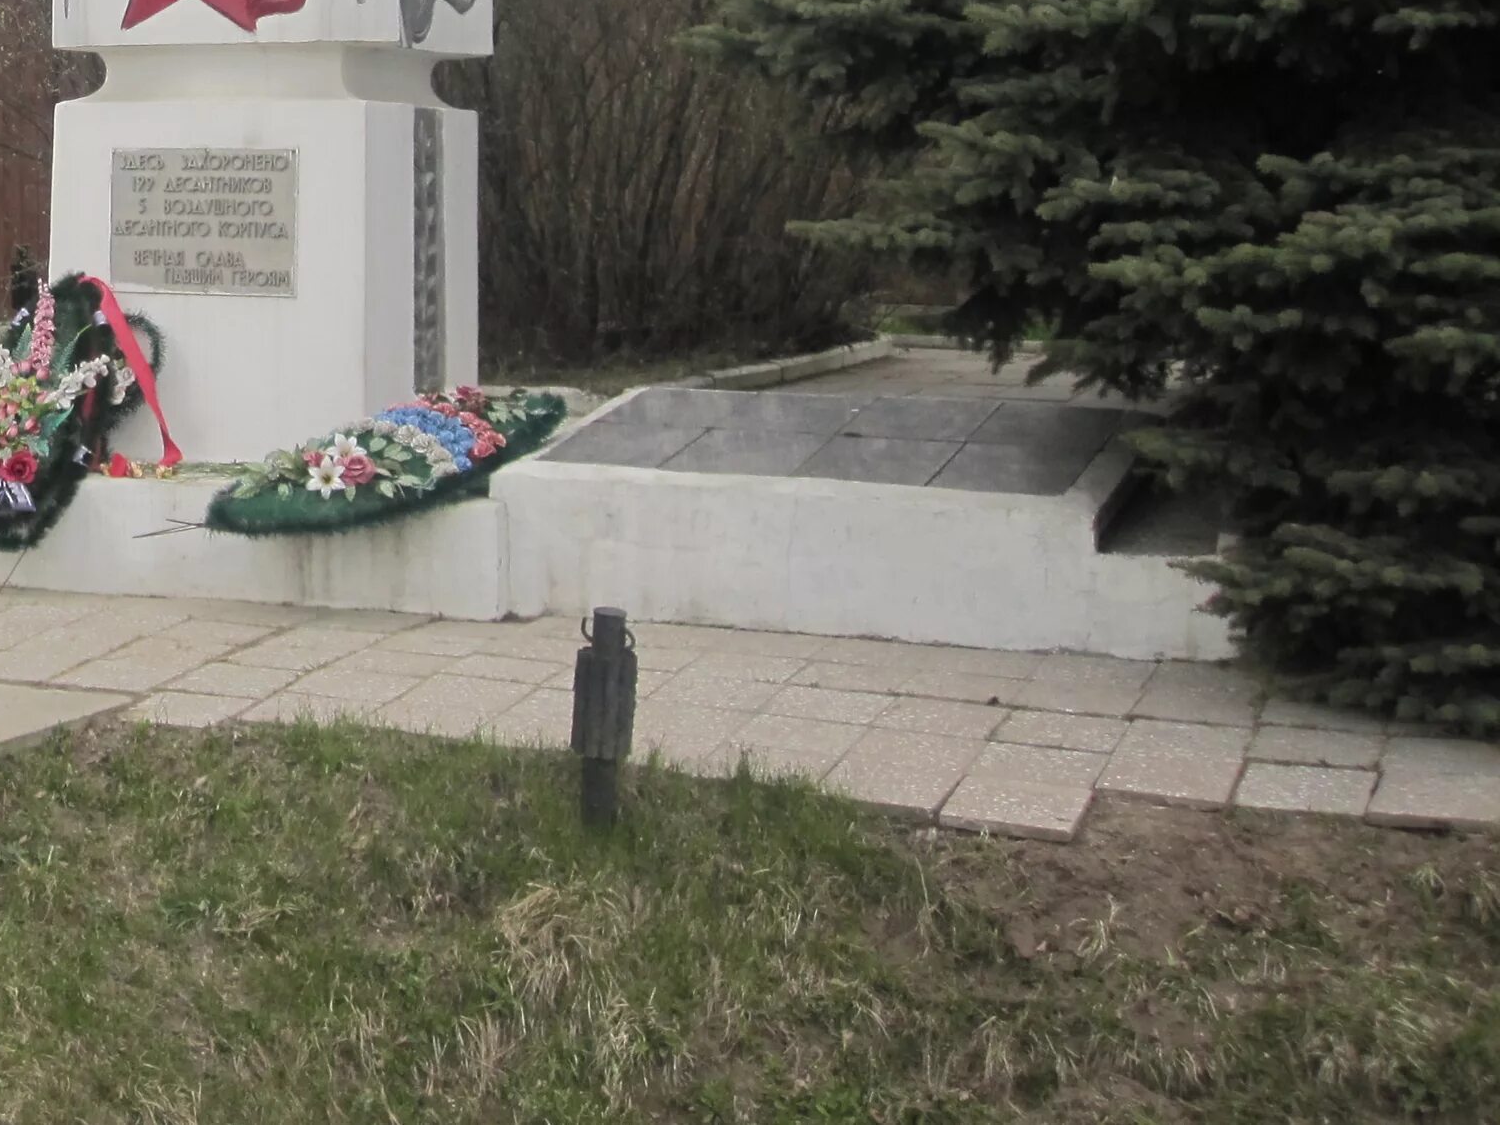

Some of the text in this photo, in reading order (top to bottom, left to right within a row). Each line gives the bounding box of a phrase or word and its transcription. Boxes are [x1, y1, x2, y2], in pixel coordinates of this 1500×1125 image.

[119, 154, 290, 173] ЗДЕСЬ ЗАХОРОНЕНО
[163, 176, 273, 194] ДЕСАНТНИКОВ
[138, 198, 275, 217] 5 ВОЗДУШНОГО
[113, 219, 289, 239] ДЕСАНТНОГО КОРПУСА
[133, 249, 248, 269] ВЕЧНАЯ СЛАВА
[163, 266, 291, 288] ПАВШИМ ГЕРОЯМ
